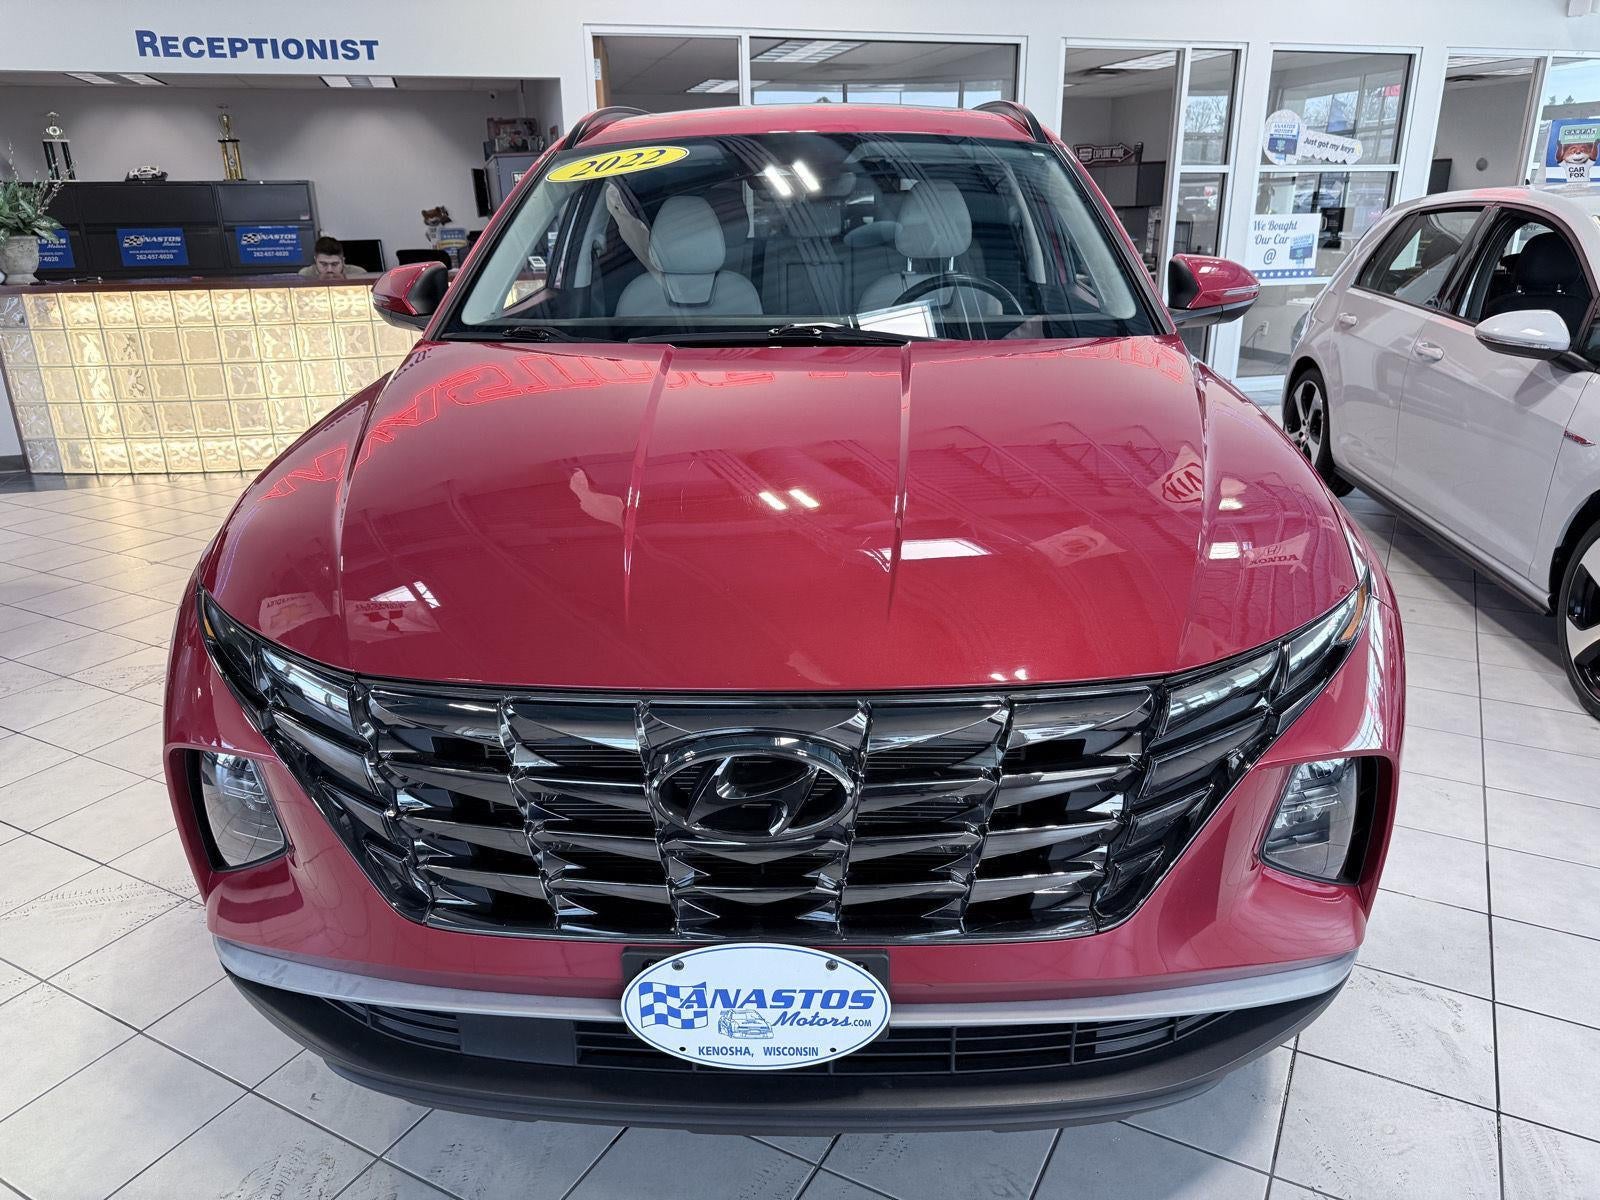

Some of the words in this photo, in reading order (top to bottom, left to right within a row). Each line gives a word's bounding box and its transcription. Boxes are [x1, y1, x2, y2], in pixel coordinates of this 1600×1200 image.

[1303, 137, 1317, 146] Just
[1317, 139, 1329, 149] got
[1329, 143, 1340, 152] my
[1341, 144, 1355, 154] keys
[570, 149, 667, 178] 2022
[1254, 220, 1267, 231] We
[1268, 220, 1297, 233] Bought
[1255, 233, 1272, 245] Our
[1273, 233, 1290, 245] Car
[678, 988, 876, 1010] ANASTOS
[698, 1046, 755, 1058] KENOSHA,
[763, 1046, 819, 1057] WISCONSIN
